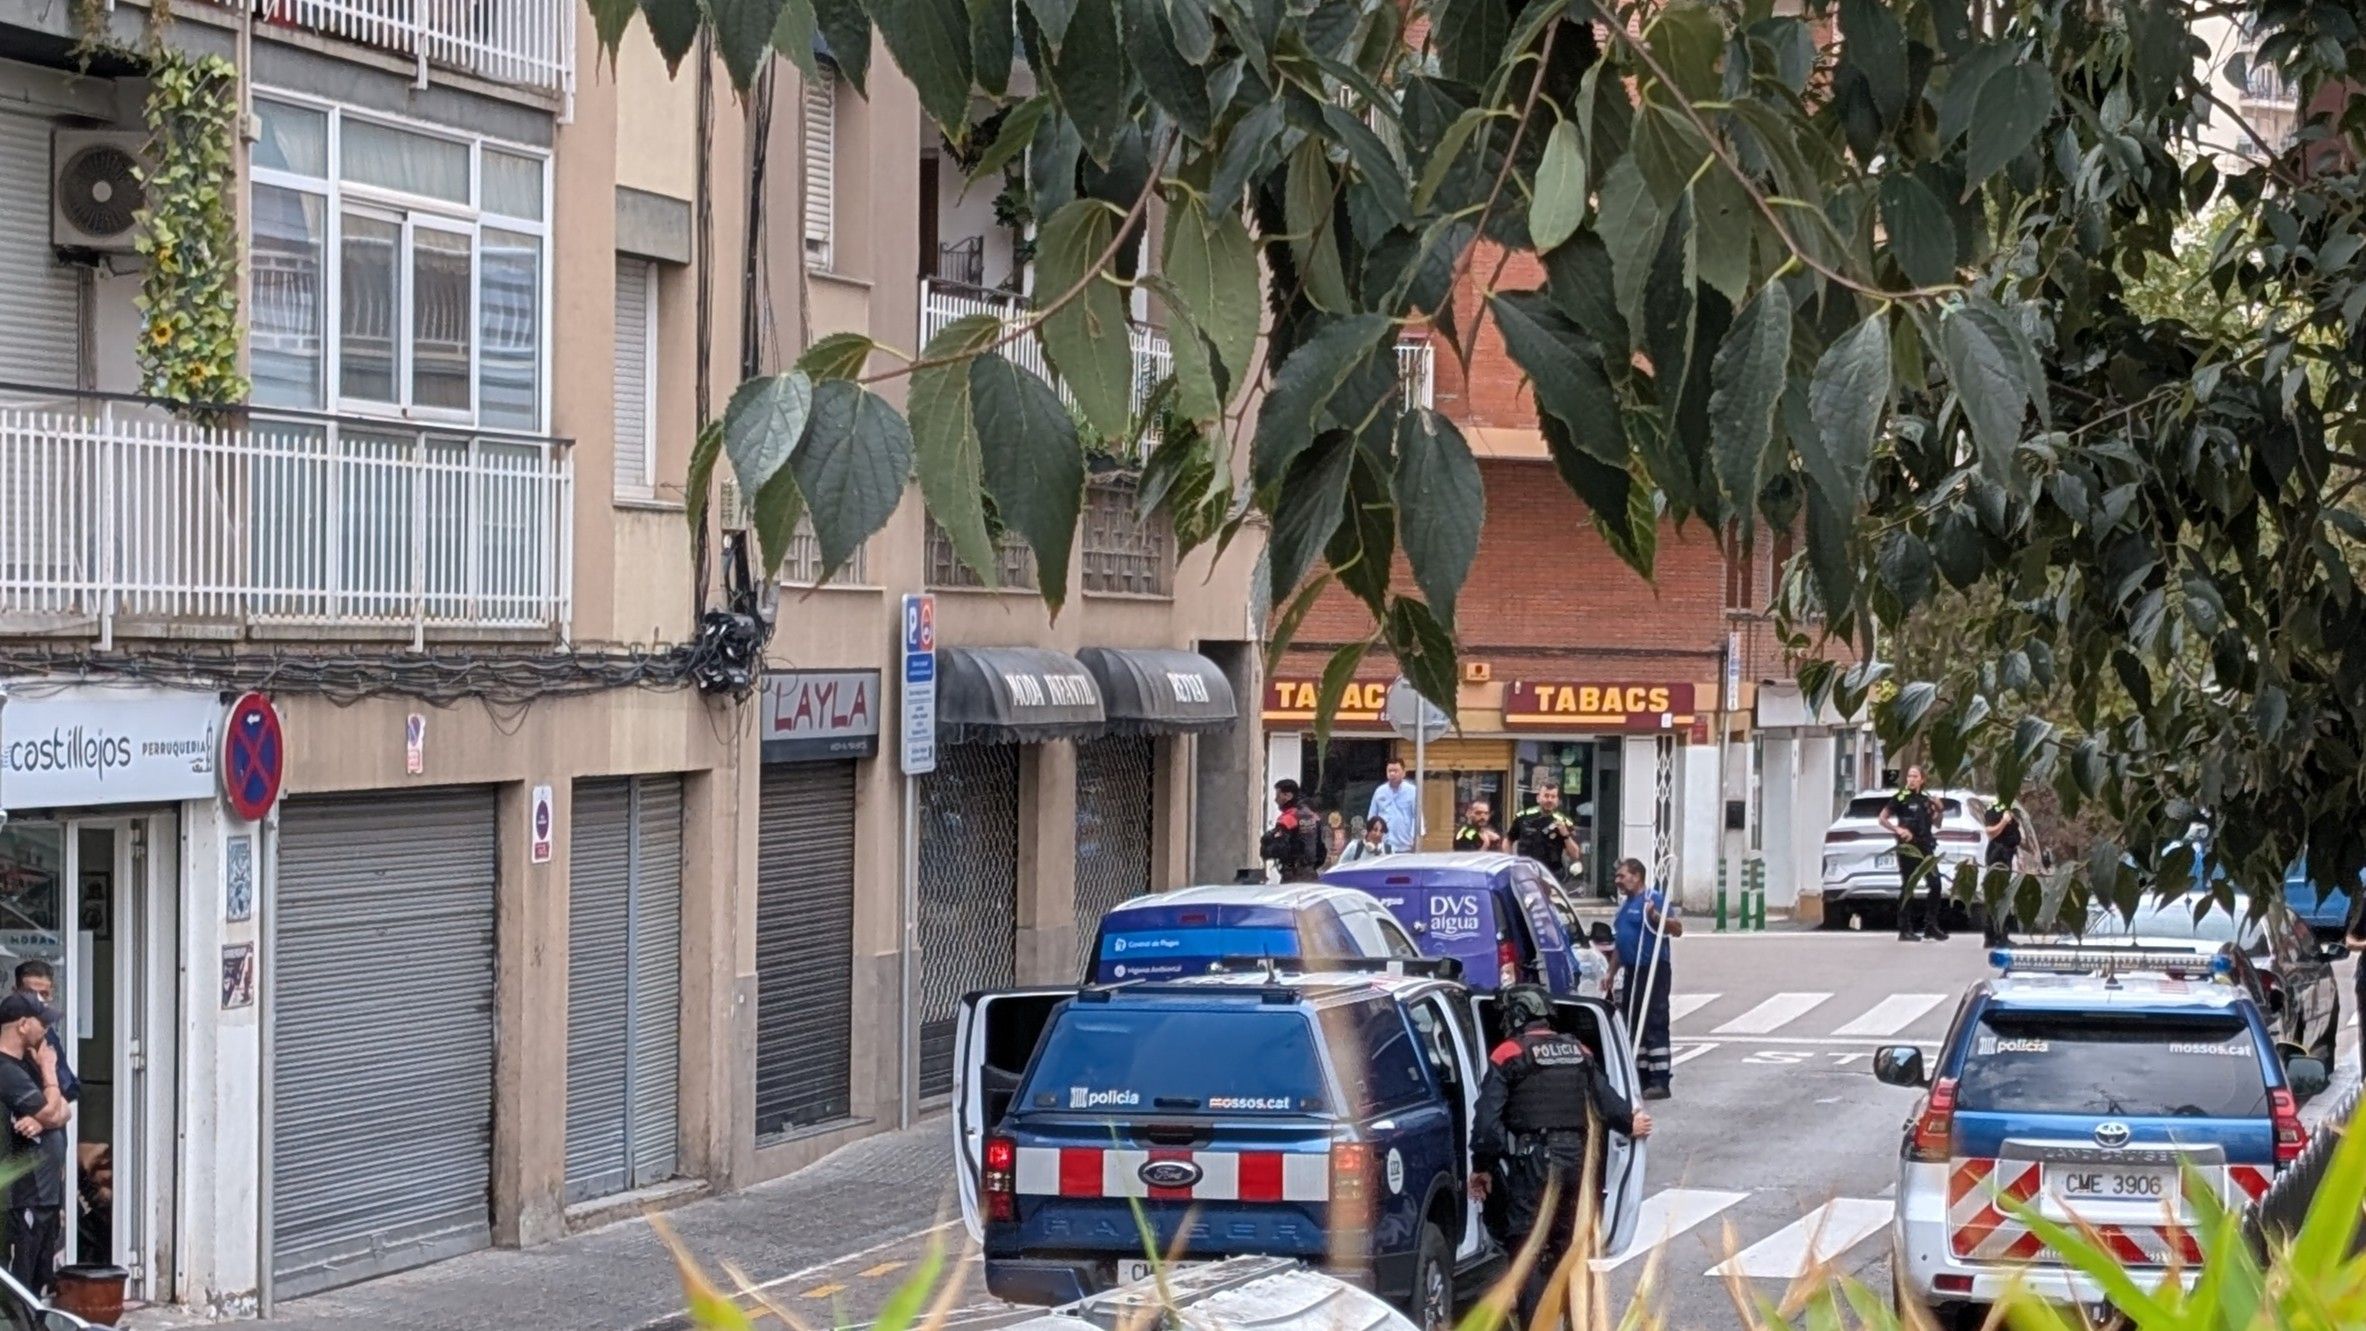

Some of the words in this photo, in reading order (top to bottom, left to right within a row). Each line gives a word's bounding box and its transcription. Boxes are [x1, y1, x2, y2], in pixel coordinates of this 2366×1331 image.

[1275, 682, 1391, 709] TAAC
[1535, 686, 1669, 713] TABACS
[774, 680, 868, 732] LAYLA
[11, 726, 131, 782] castillejos
[142, 741, 206, 757] PERRUQUERIA
[1430, 896, 1478, 916] DVS
[1431, 916, 1478, 934] aigua
[1997, 1040, 2049, 1053] policia
[2169, 1042, 2251, 1056] mossos.cat
[1088, 1089, 1140, 1107] policia
[1209, 1096, 1290, 1109] mossos.cat
[2066, 1173, 2103, 1194] CME
[2112, 1174, 2163, 1196] 3906
